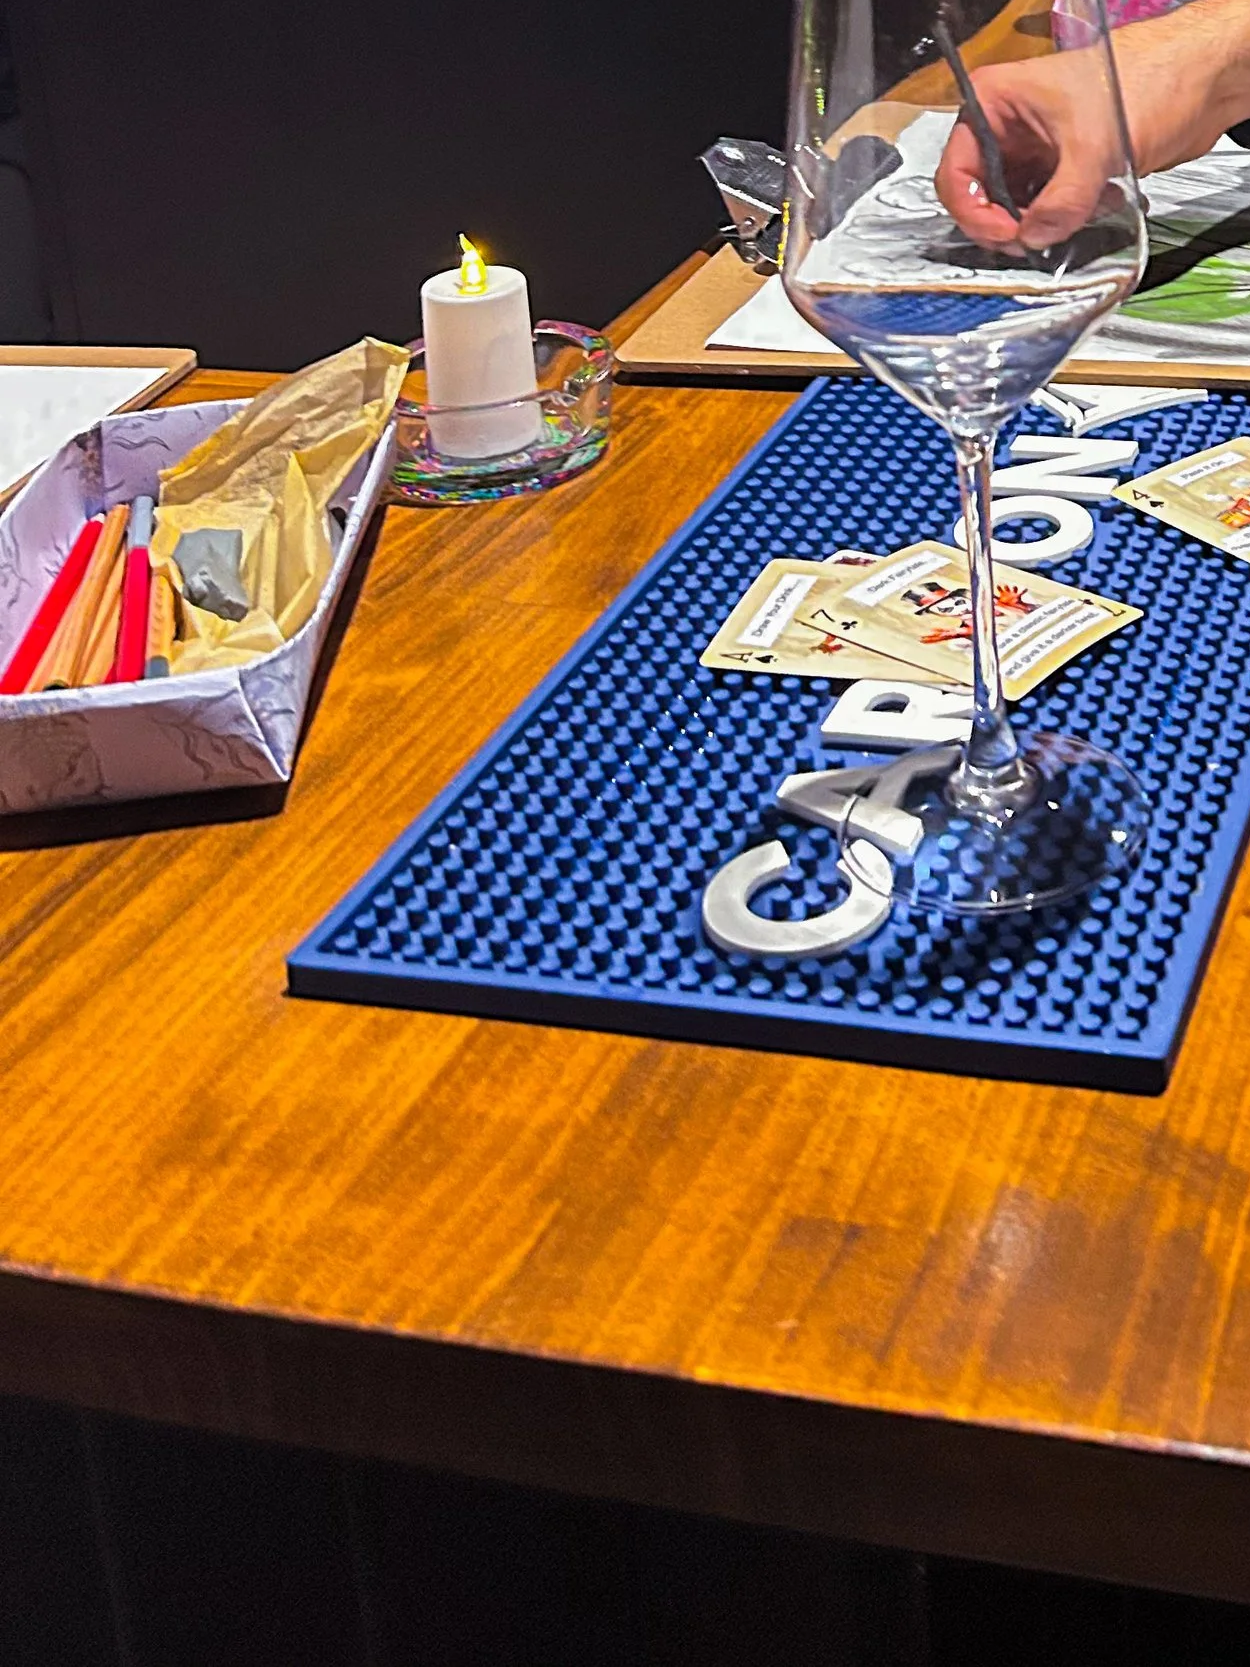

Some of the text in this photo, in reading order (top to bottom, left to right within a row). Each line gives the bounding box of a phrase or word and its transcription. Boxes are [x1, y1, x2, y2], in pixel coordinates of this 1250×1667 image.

[1132, 489, 1151, 501] 4
[810, 608, 836, 623] 7
[719, 651, 754, 664] A
